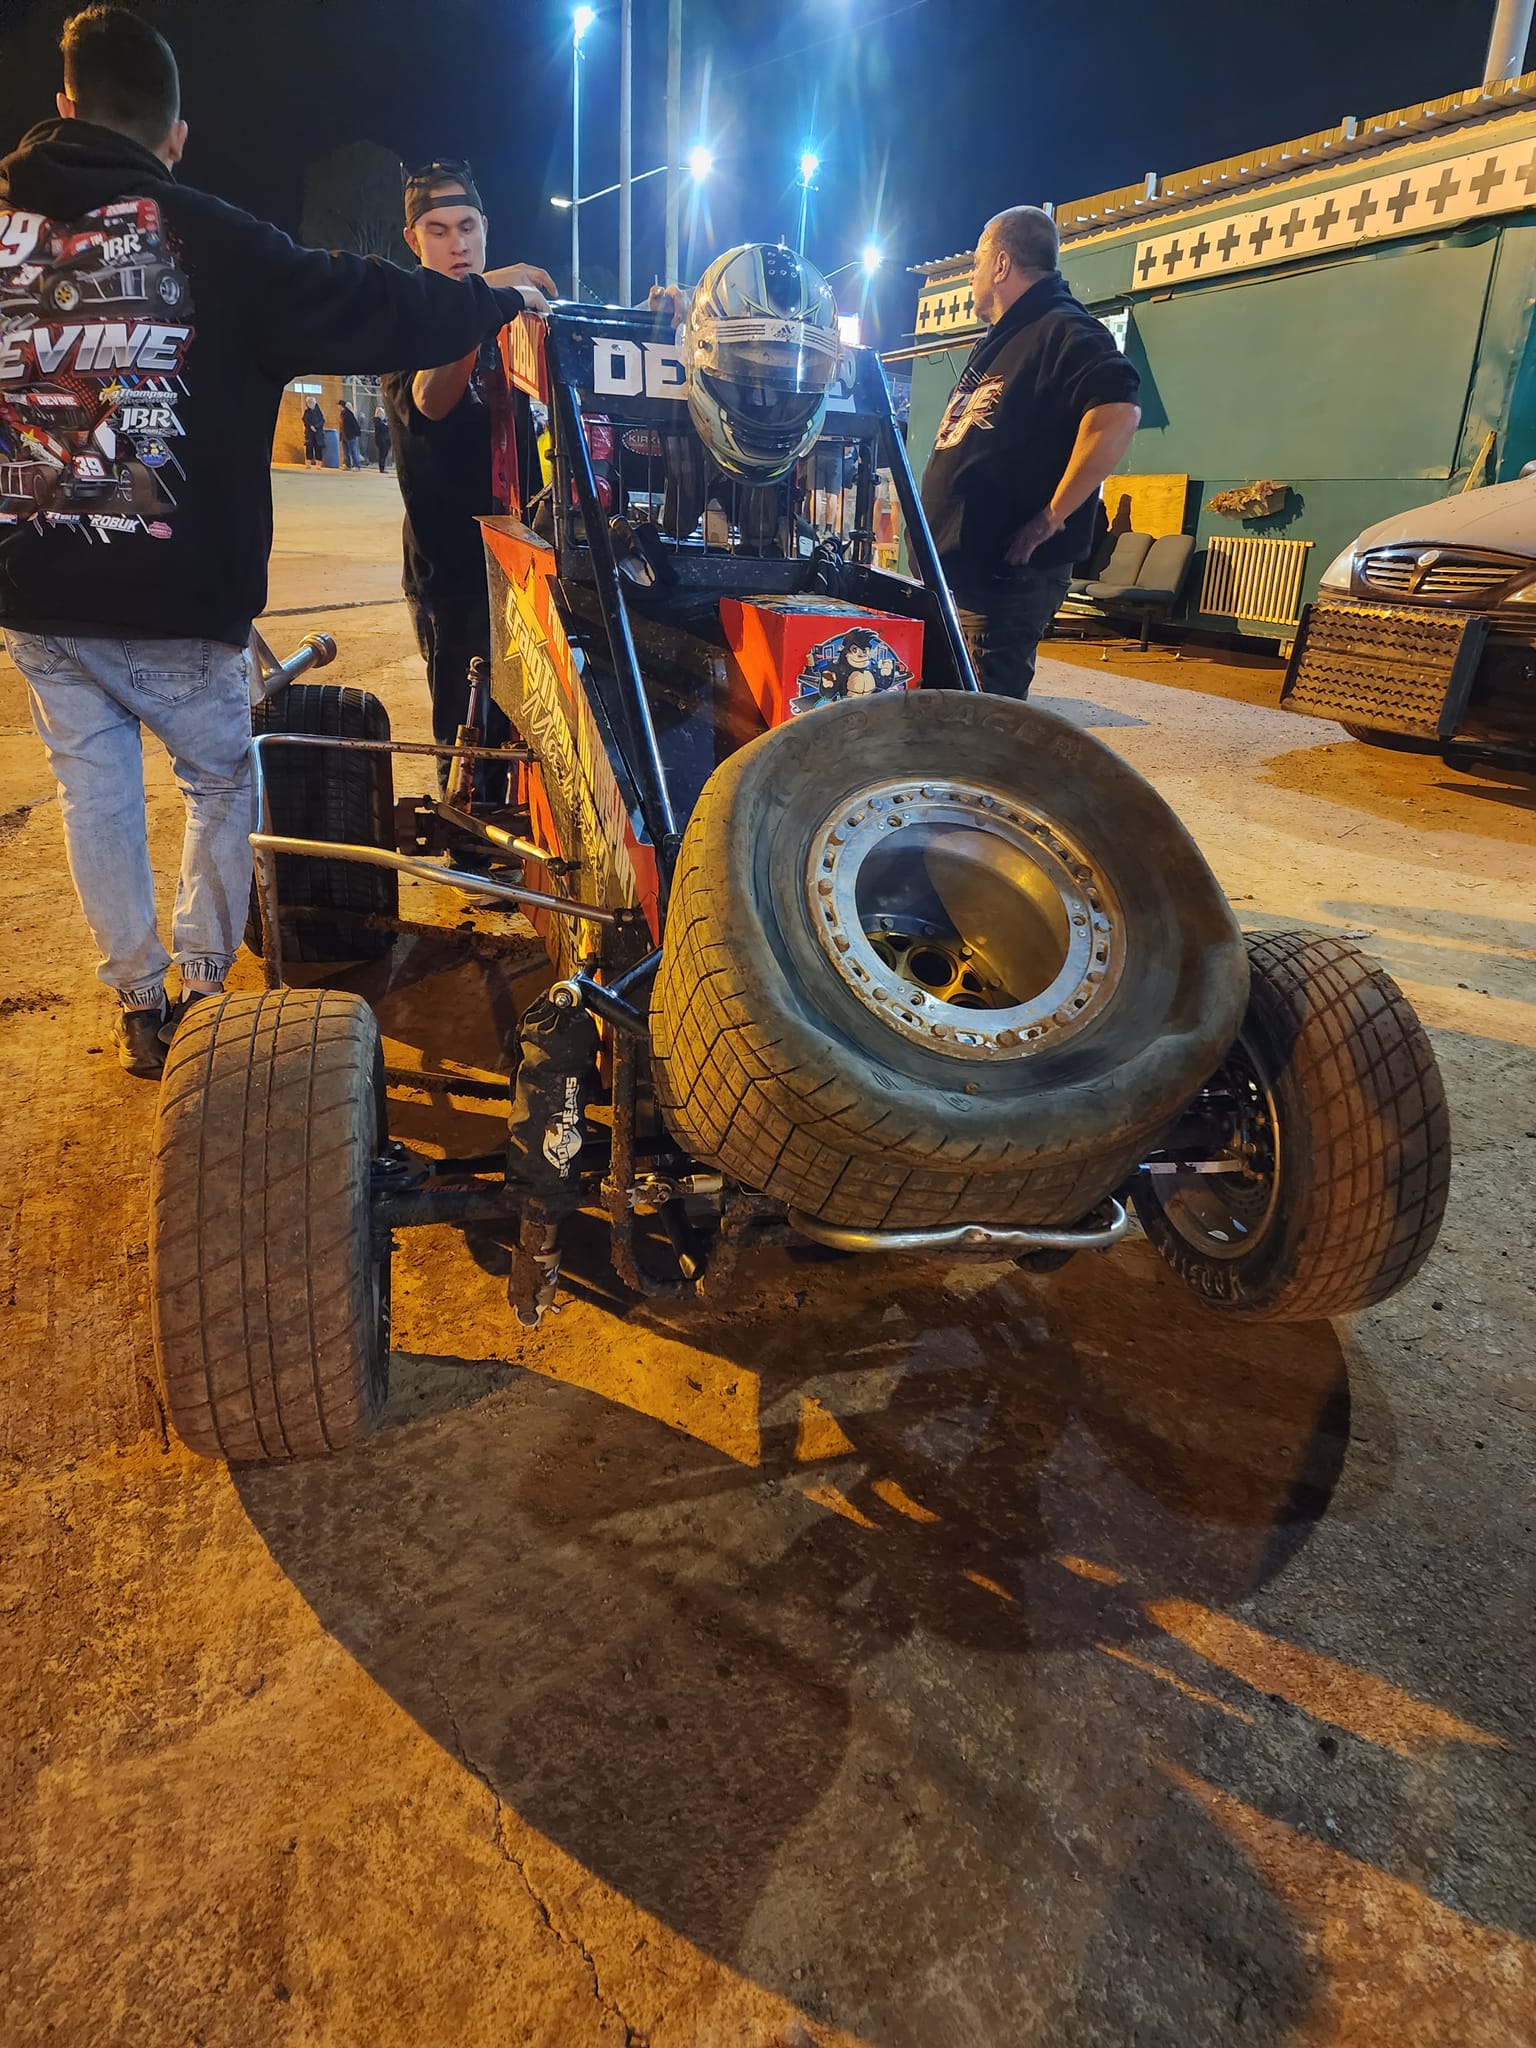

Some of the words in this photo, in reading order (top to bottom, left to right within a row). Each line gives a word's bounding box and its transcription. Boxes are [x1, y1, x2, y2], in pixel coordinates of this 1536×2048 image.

[0, 211, 47, 268] 9
[0, 323, 190, 379] EVINE
[36, 396, 77, 406] DEVINE
[120, 408, 172, 431] JBR
[75, 457, 105, 477] 39
[91, 514, 140, 531] ROBUK
